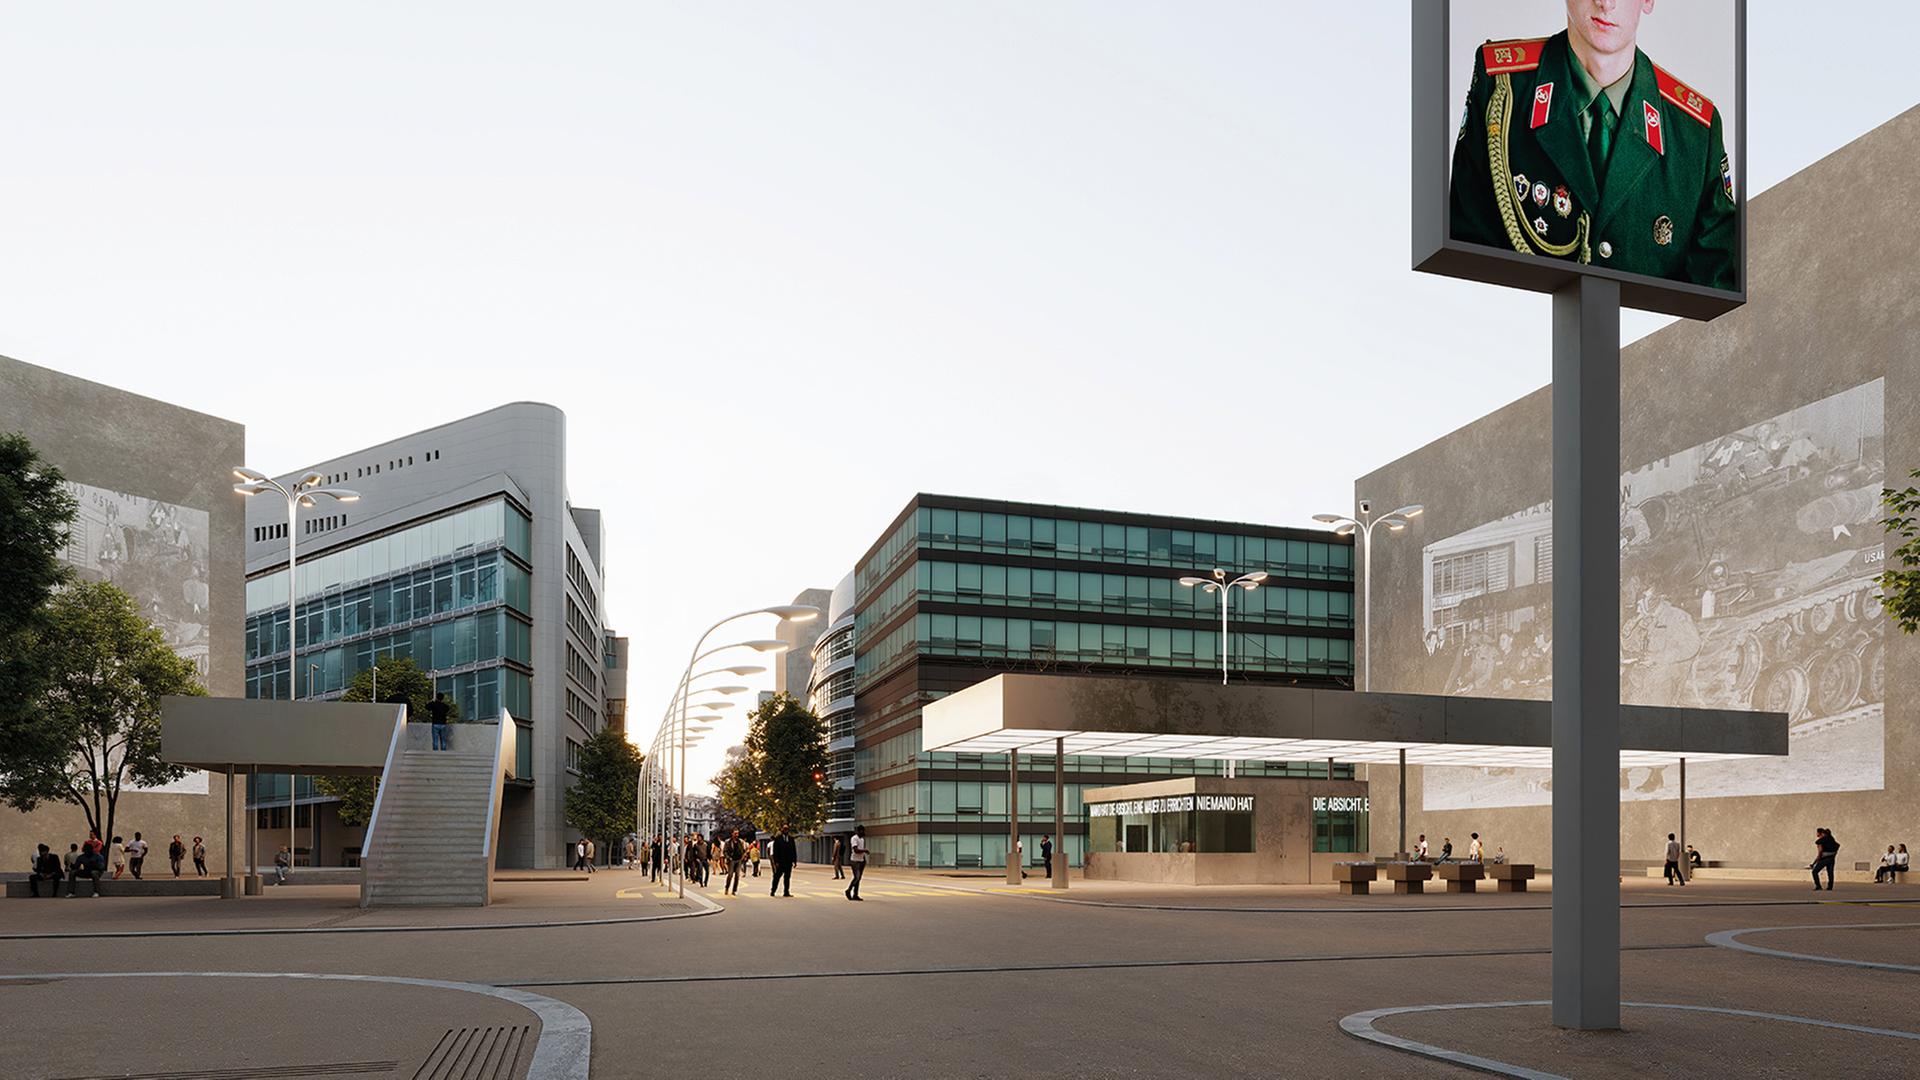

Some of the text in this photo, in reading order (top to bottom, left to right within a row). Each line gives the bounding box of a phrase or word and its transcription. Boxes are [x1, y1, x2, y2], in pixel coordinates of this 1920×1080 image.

[1197, 796, 1254, 811] NIEMAND HAT
[1313, 797, 1326, 811] DIE
[1327, 797, 1363, 813] ABSICHT,
